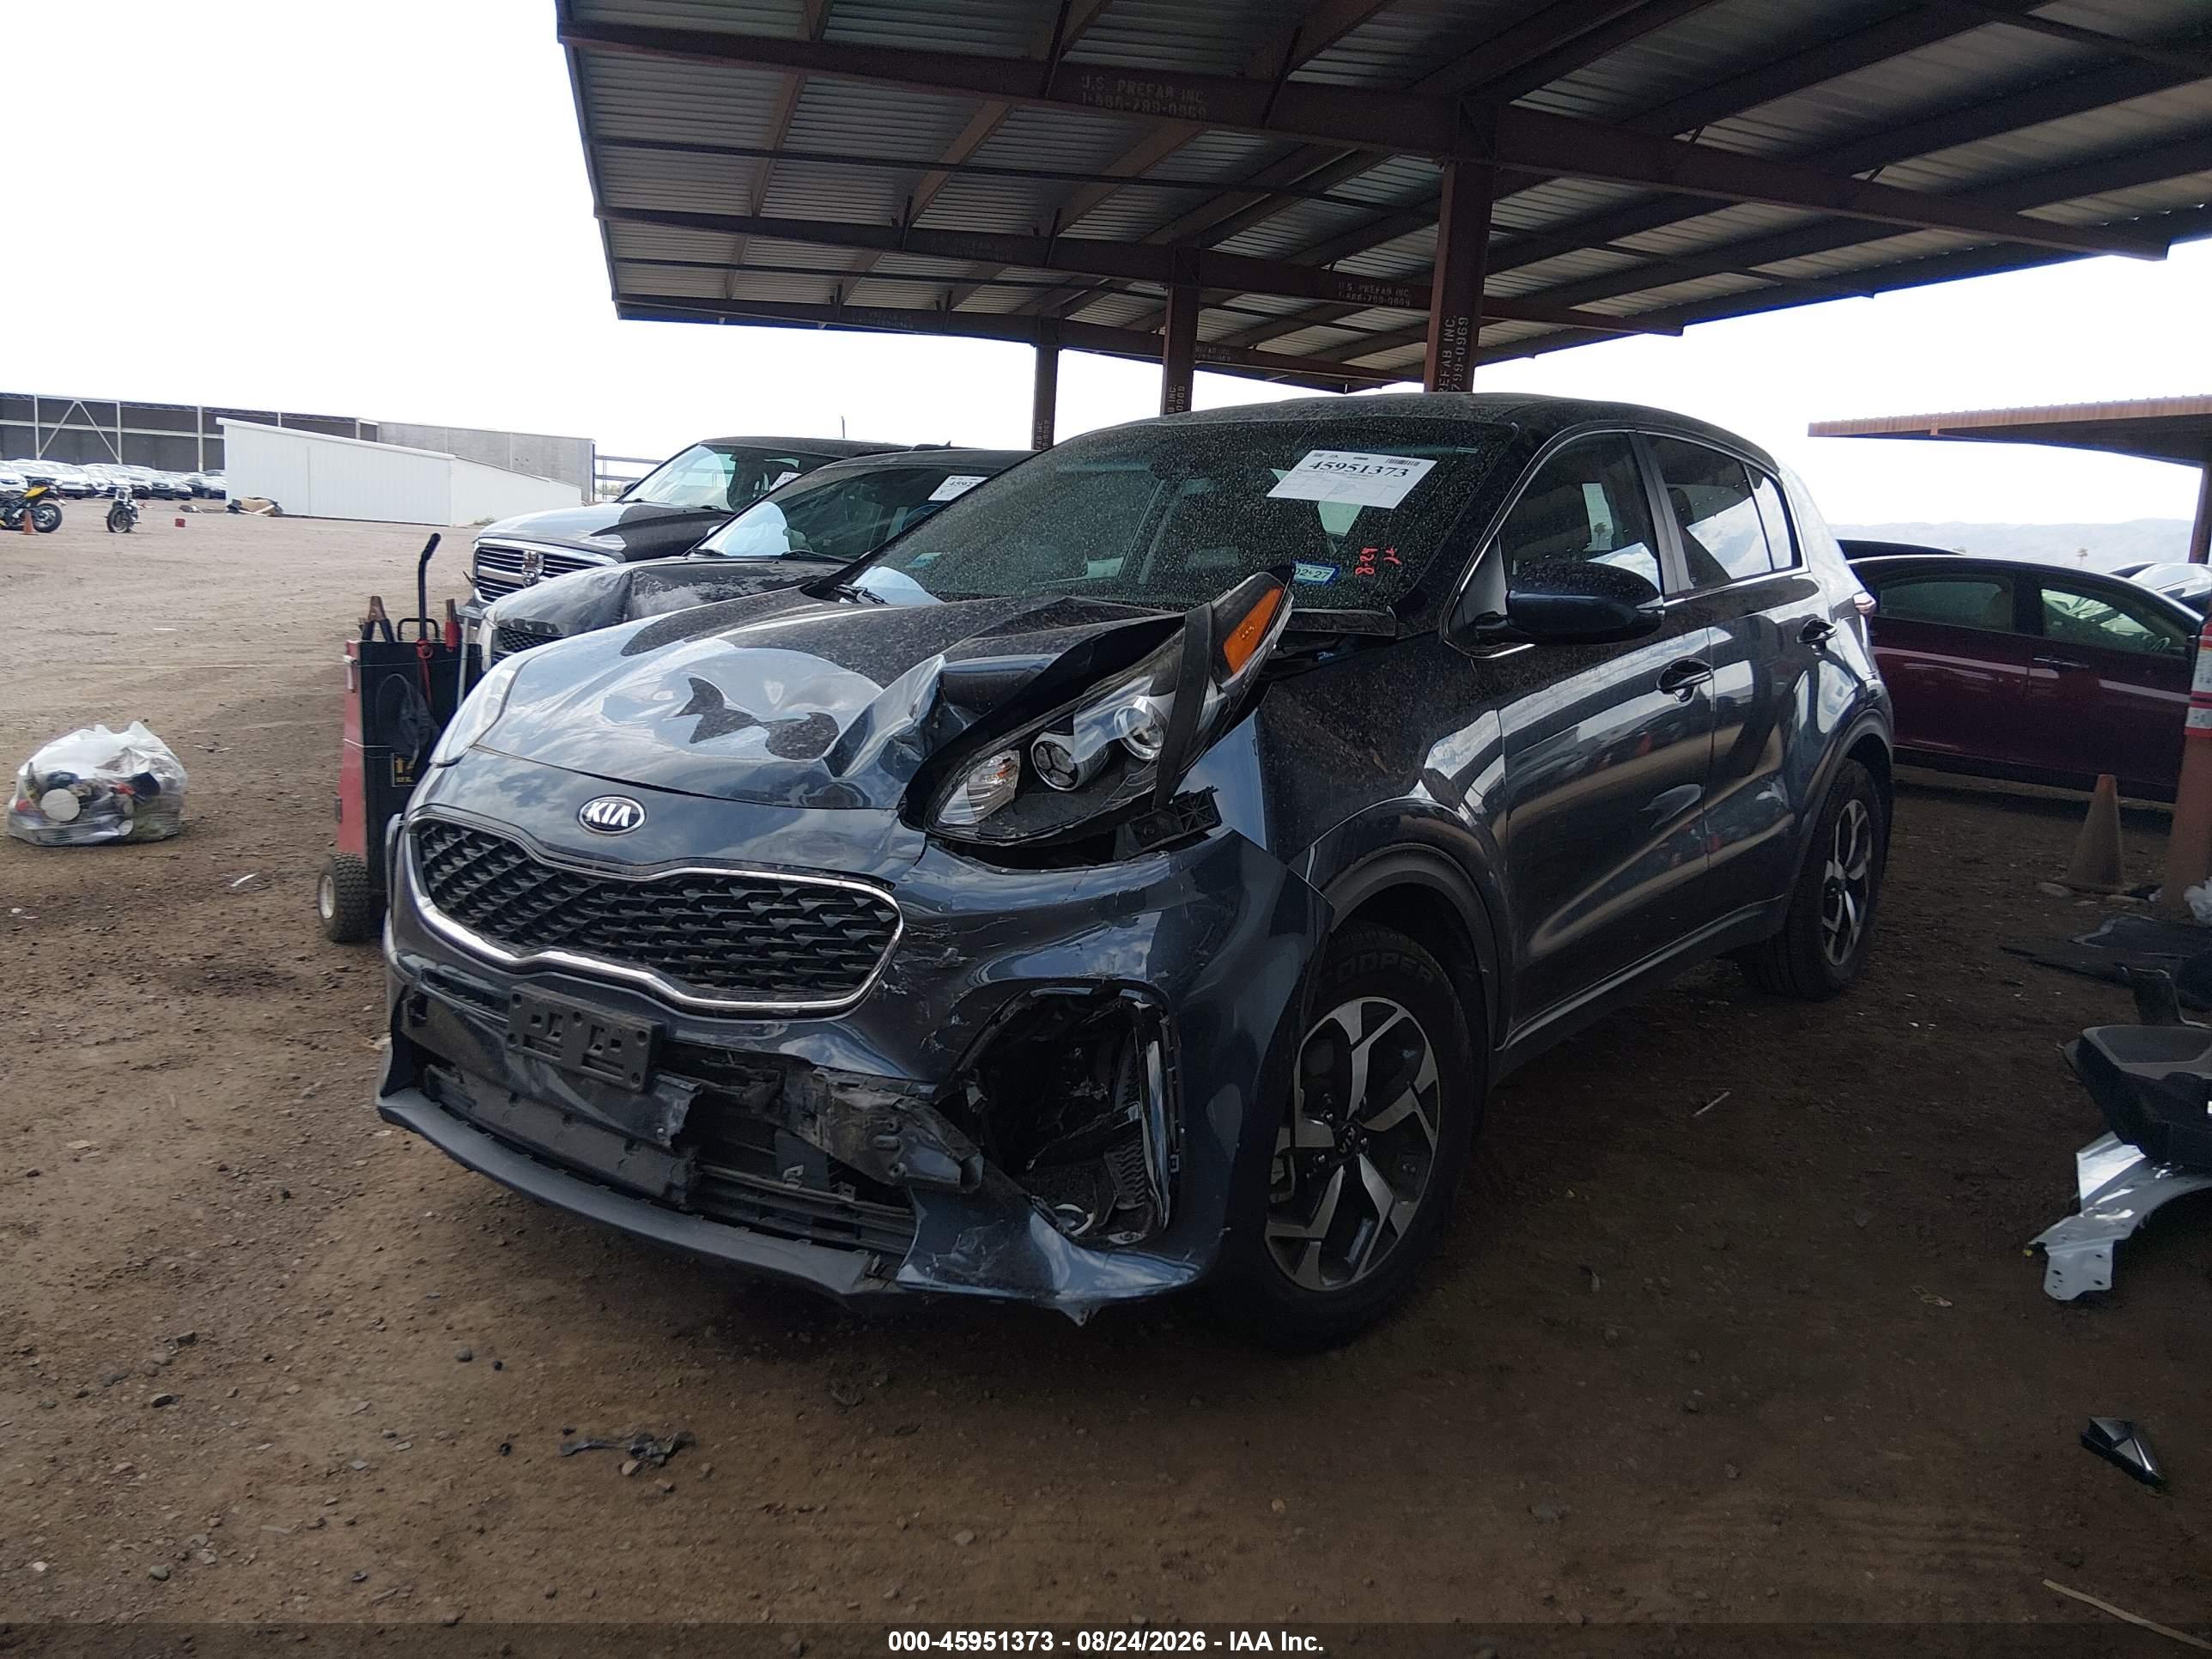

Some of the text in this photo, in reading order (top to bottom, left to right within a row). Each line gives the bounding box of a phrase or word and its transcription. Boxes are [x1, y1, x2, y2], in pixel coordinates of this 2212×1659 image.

[1309, 461, 1409, 477] 45951373
[1312, 570, 1331, 579] 27
[586, 801, 632, 827] KIA
